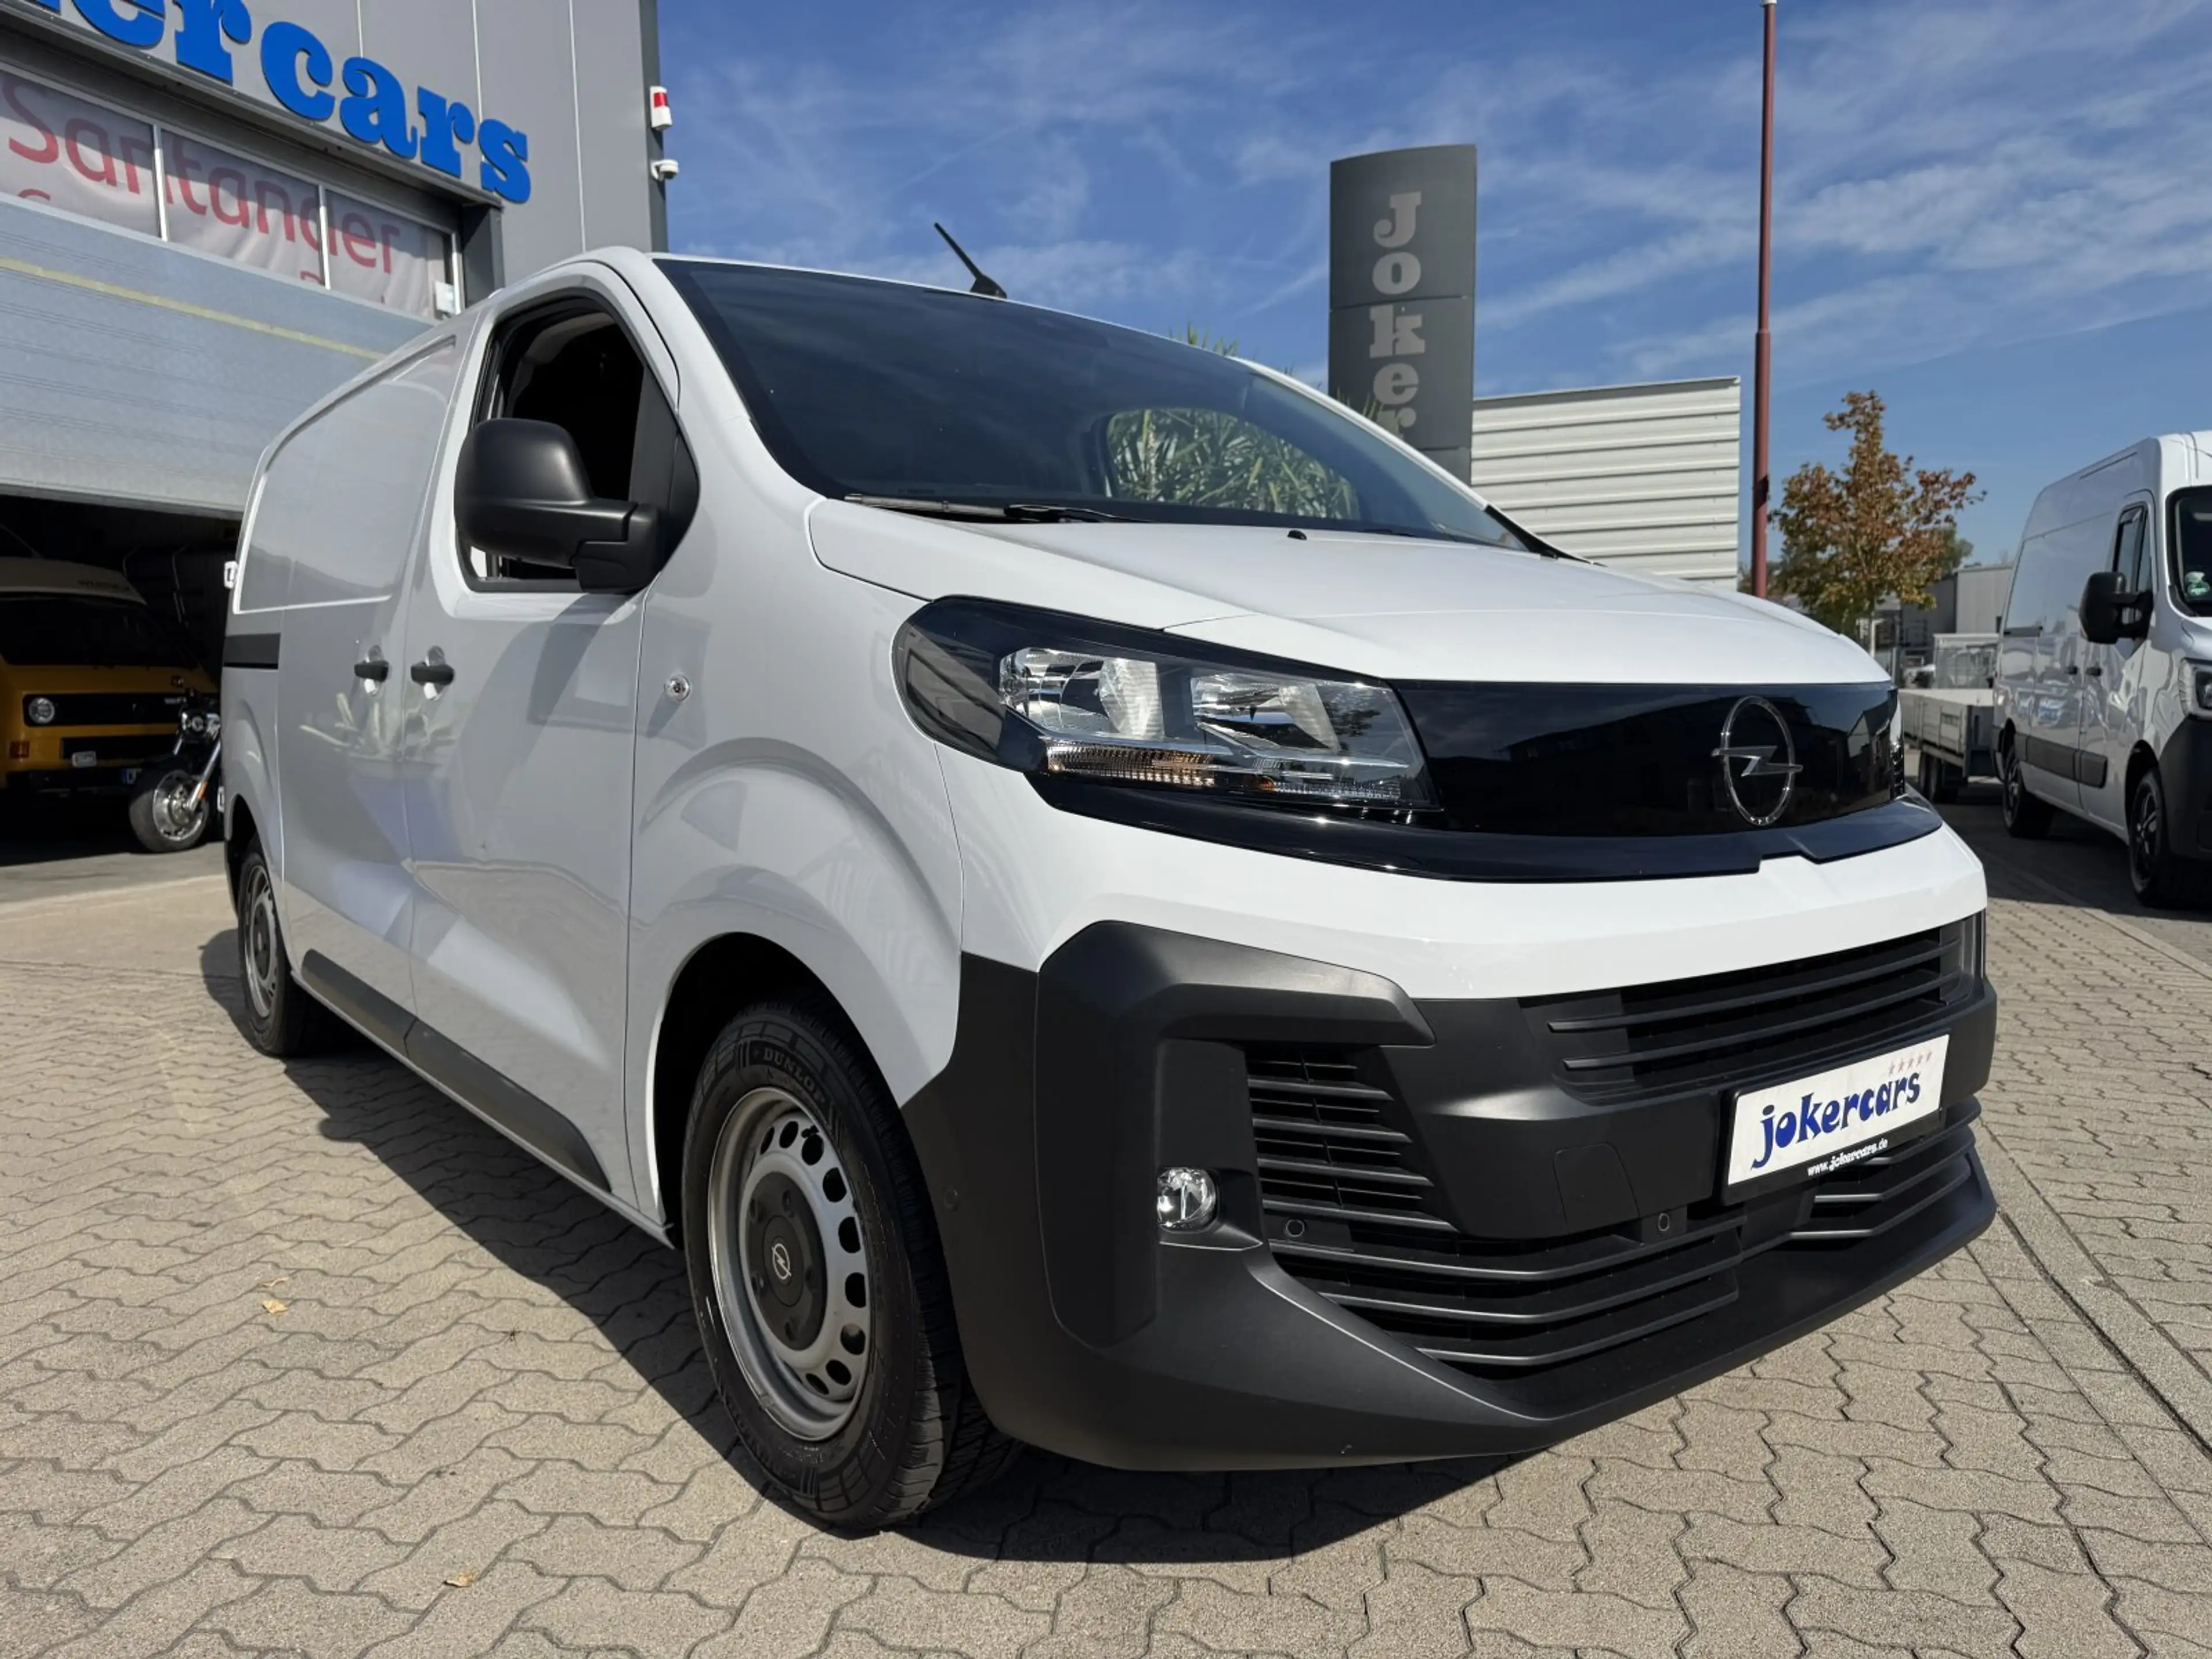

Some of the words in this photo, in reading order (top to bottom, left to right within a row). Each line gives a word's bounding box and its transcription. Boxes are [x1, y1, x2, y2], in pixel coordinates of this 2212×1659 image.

[33, 0, 531, 203] ercars
[3, 77, 400, 274] Santander
[763, 1047, 825, 1103] DUNLOP
[1750, 1072, 1922, 1170] jokercars
